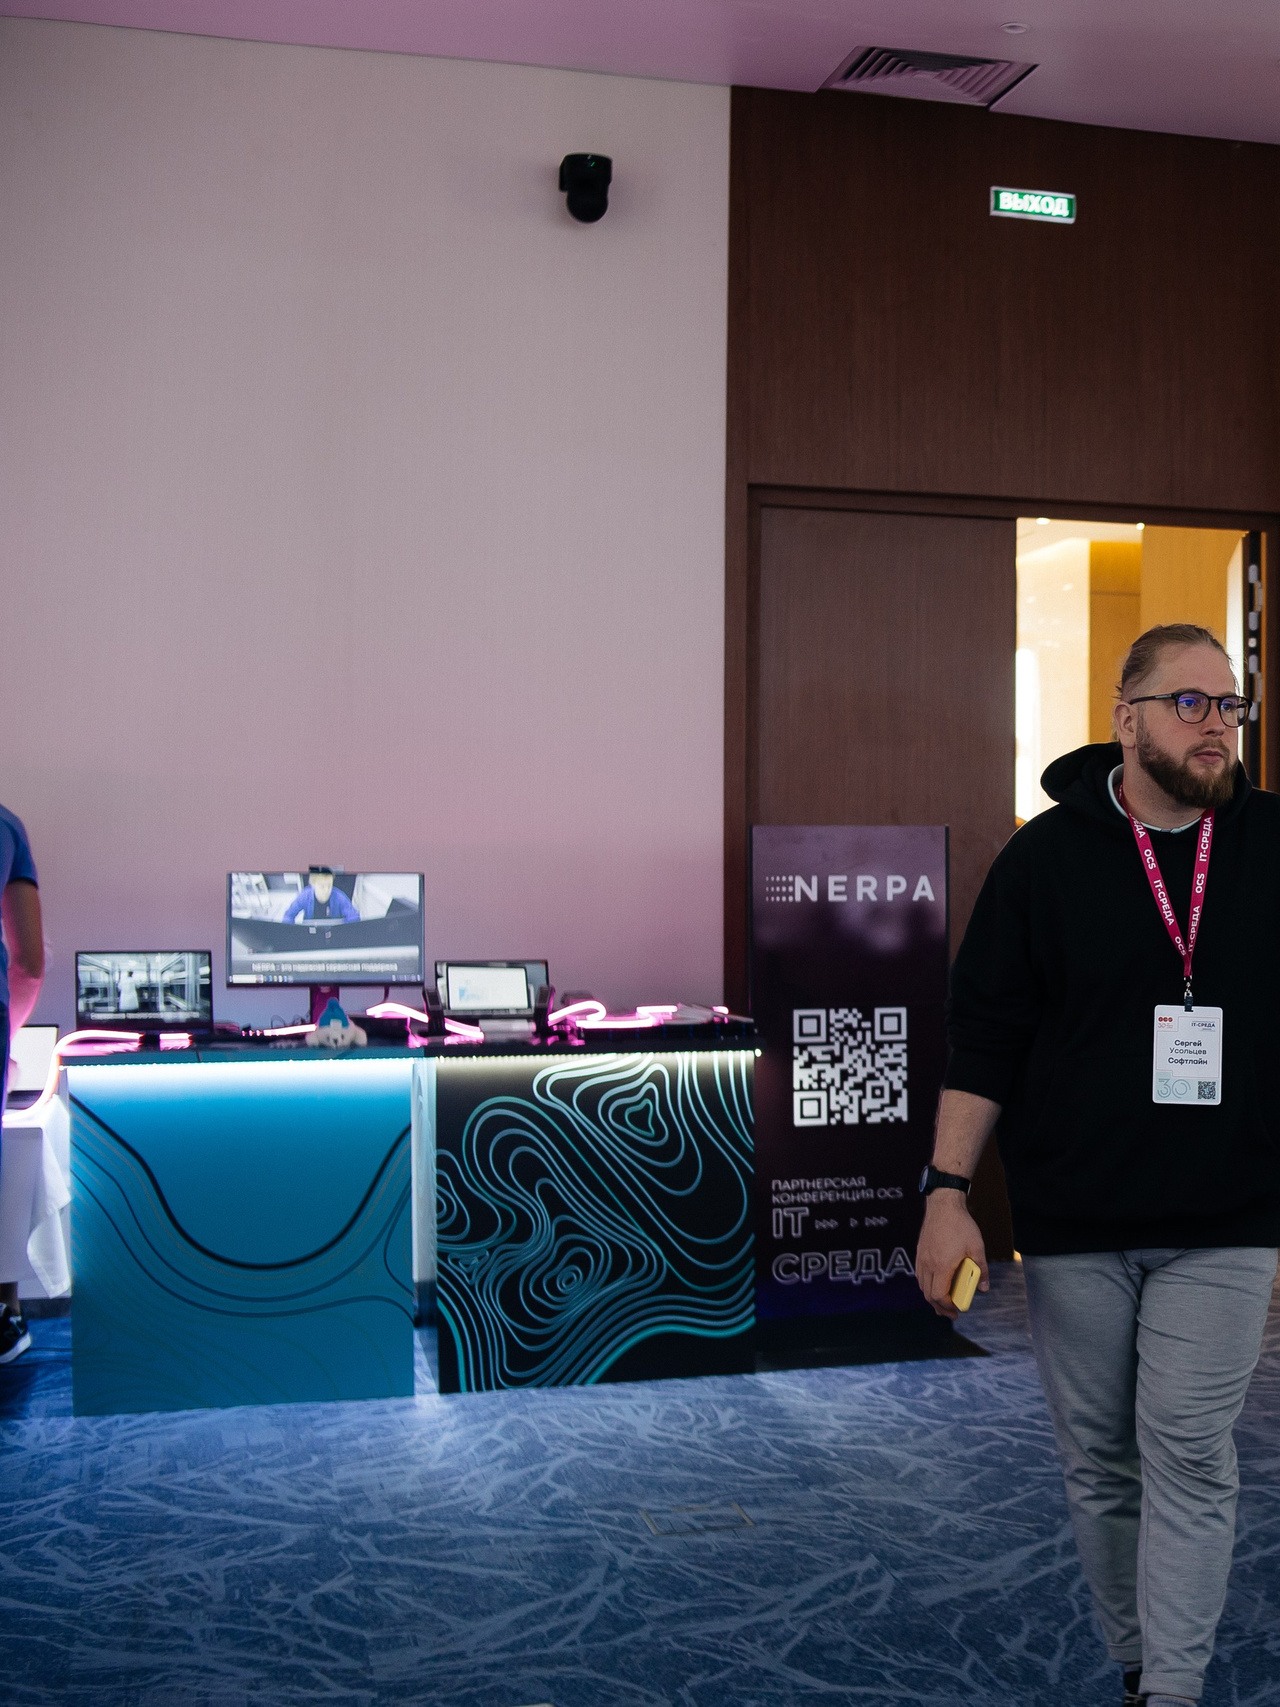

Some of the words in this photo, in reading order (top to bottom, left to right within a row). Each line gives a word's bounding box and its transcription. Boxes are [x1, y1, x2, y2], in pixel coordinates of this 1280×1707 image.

[999, 191, 1069, 217] ВЫХОД
[1199, 816, 1212, 862] IT-СРЕДА
[794, 874, 936, 902] NERPA
[1144, 848, 1157, 870] OCS
[1153, 879, 1175, 926] IT-СРЕДА
[1195, 873, 1205, 894] OCS
[1169, 1047, 1207, 1055] Усольцев
[1174, 1039, 1202, 1048] Сергей
[1168, 1057, 1208, 1066] Софтлайн
[771, 1176, 867, 1192] ПАРТНЕРСКАЯ
[771, 1188, 875, 1205] КОНФЕРЕНЦИЯ
[876, 1187, 903, 1199] OCS
[772, 1206, 810, 1239] IT
[771, 1247, 916, 1285] СРЕДА
